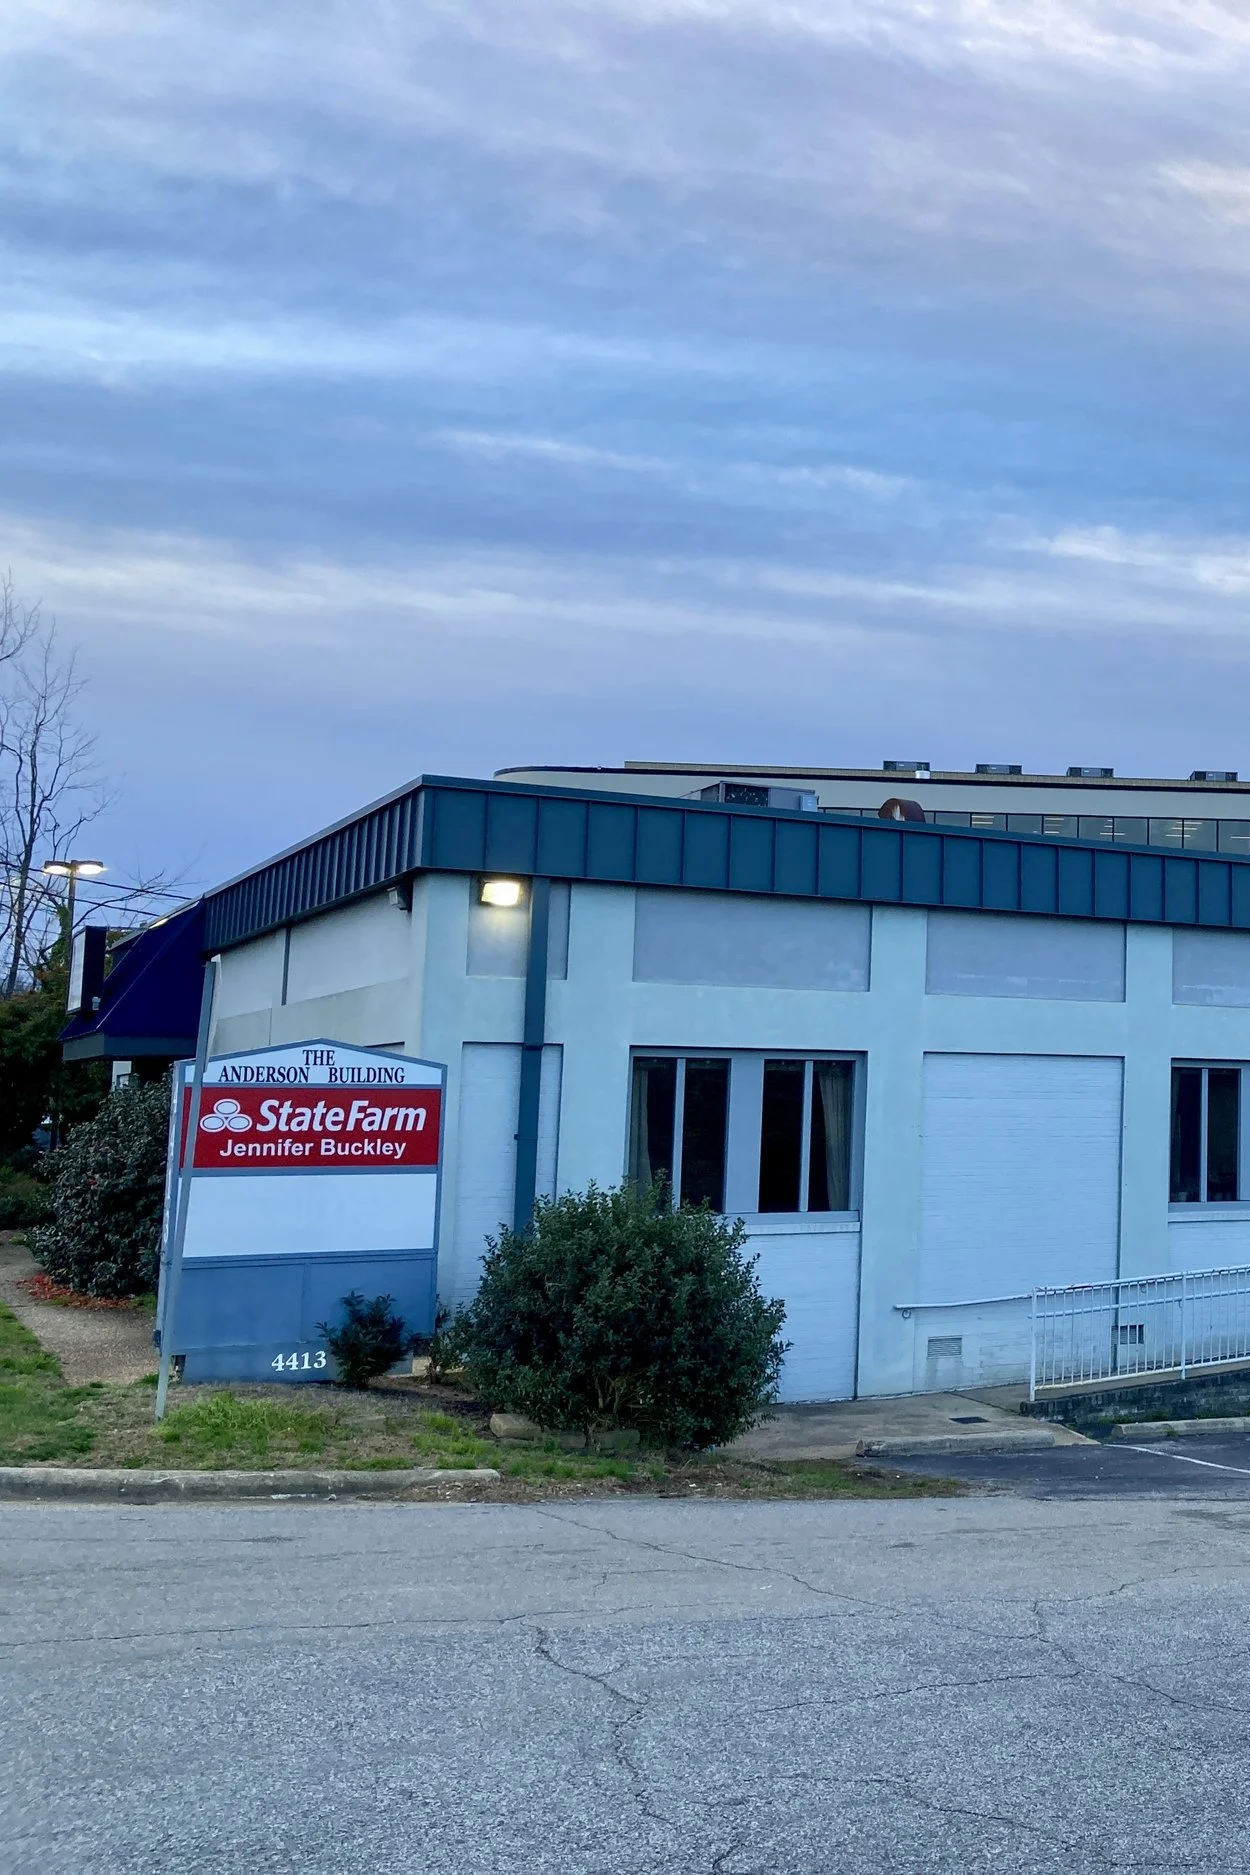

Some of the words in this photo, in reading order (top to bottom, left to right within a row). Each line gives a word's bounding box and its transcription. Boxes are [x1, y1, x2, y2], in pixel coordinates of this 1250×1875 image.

[302, 1050, 335, 1066] THE
[218, 1066, 309, 1083] ANDERSON
[328, 1067, 405, 1084] BUILDING
[219, 1139, 313, 1157] Jennifer
[320, 1138, 407, 1159] Buckley
[271, 1350, 327, 1372] 4413
